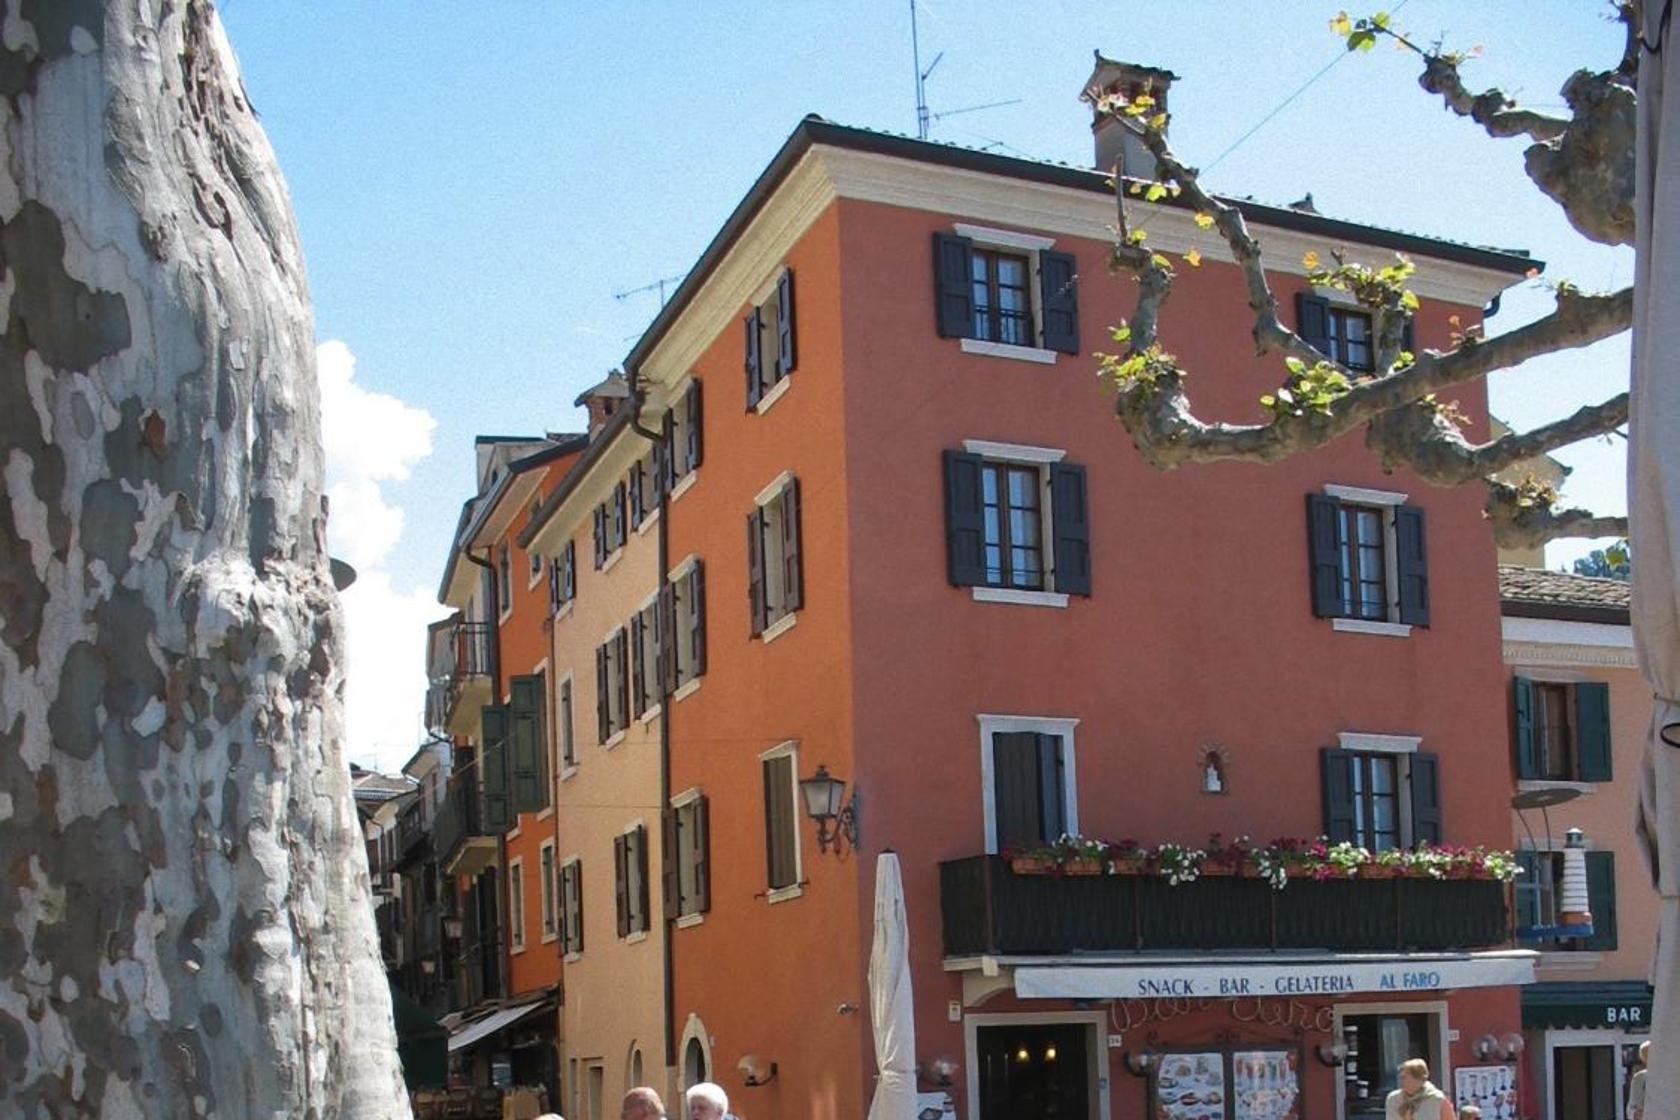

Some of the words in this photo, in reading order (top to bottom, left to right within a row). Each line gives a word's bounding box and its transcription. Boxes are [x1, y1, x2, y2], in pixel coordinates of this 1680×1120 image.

[1138, 978, 1195, 995] SNACK
[1219, 977, 1250, 994] BAR
[1274, 975, 1355, 993] GELATERIA
[1379, 973, 1397, 989] AL
[1403, 971, 1440, 988] FARO
[1607, 1006, 1641, 1022] BAR
